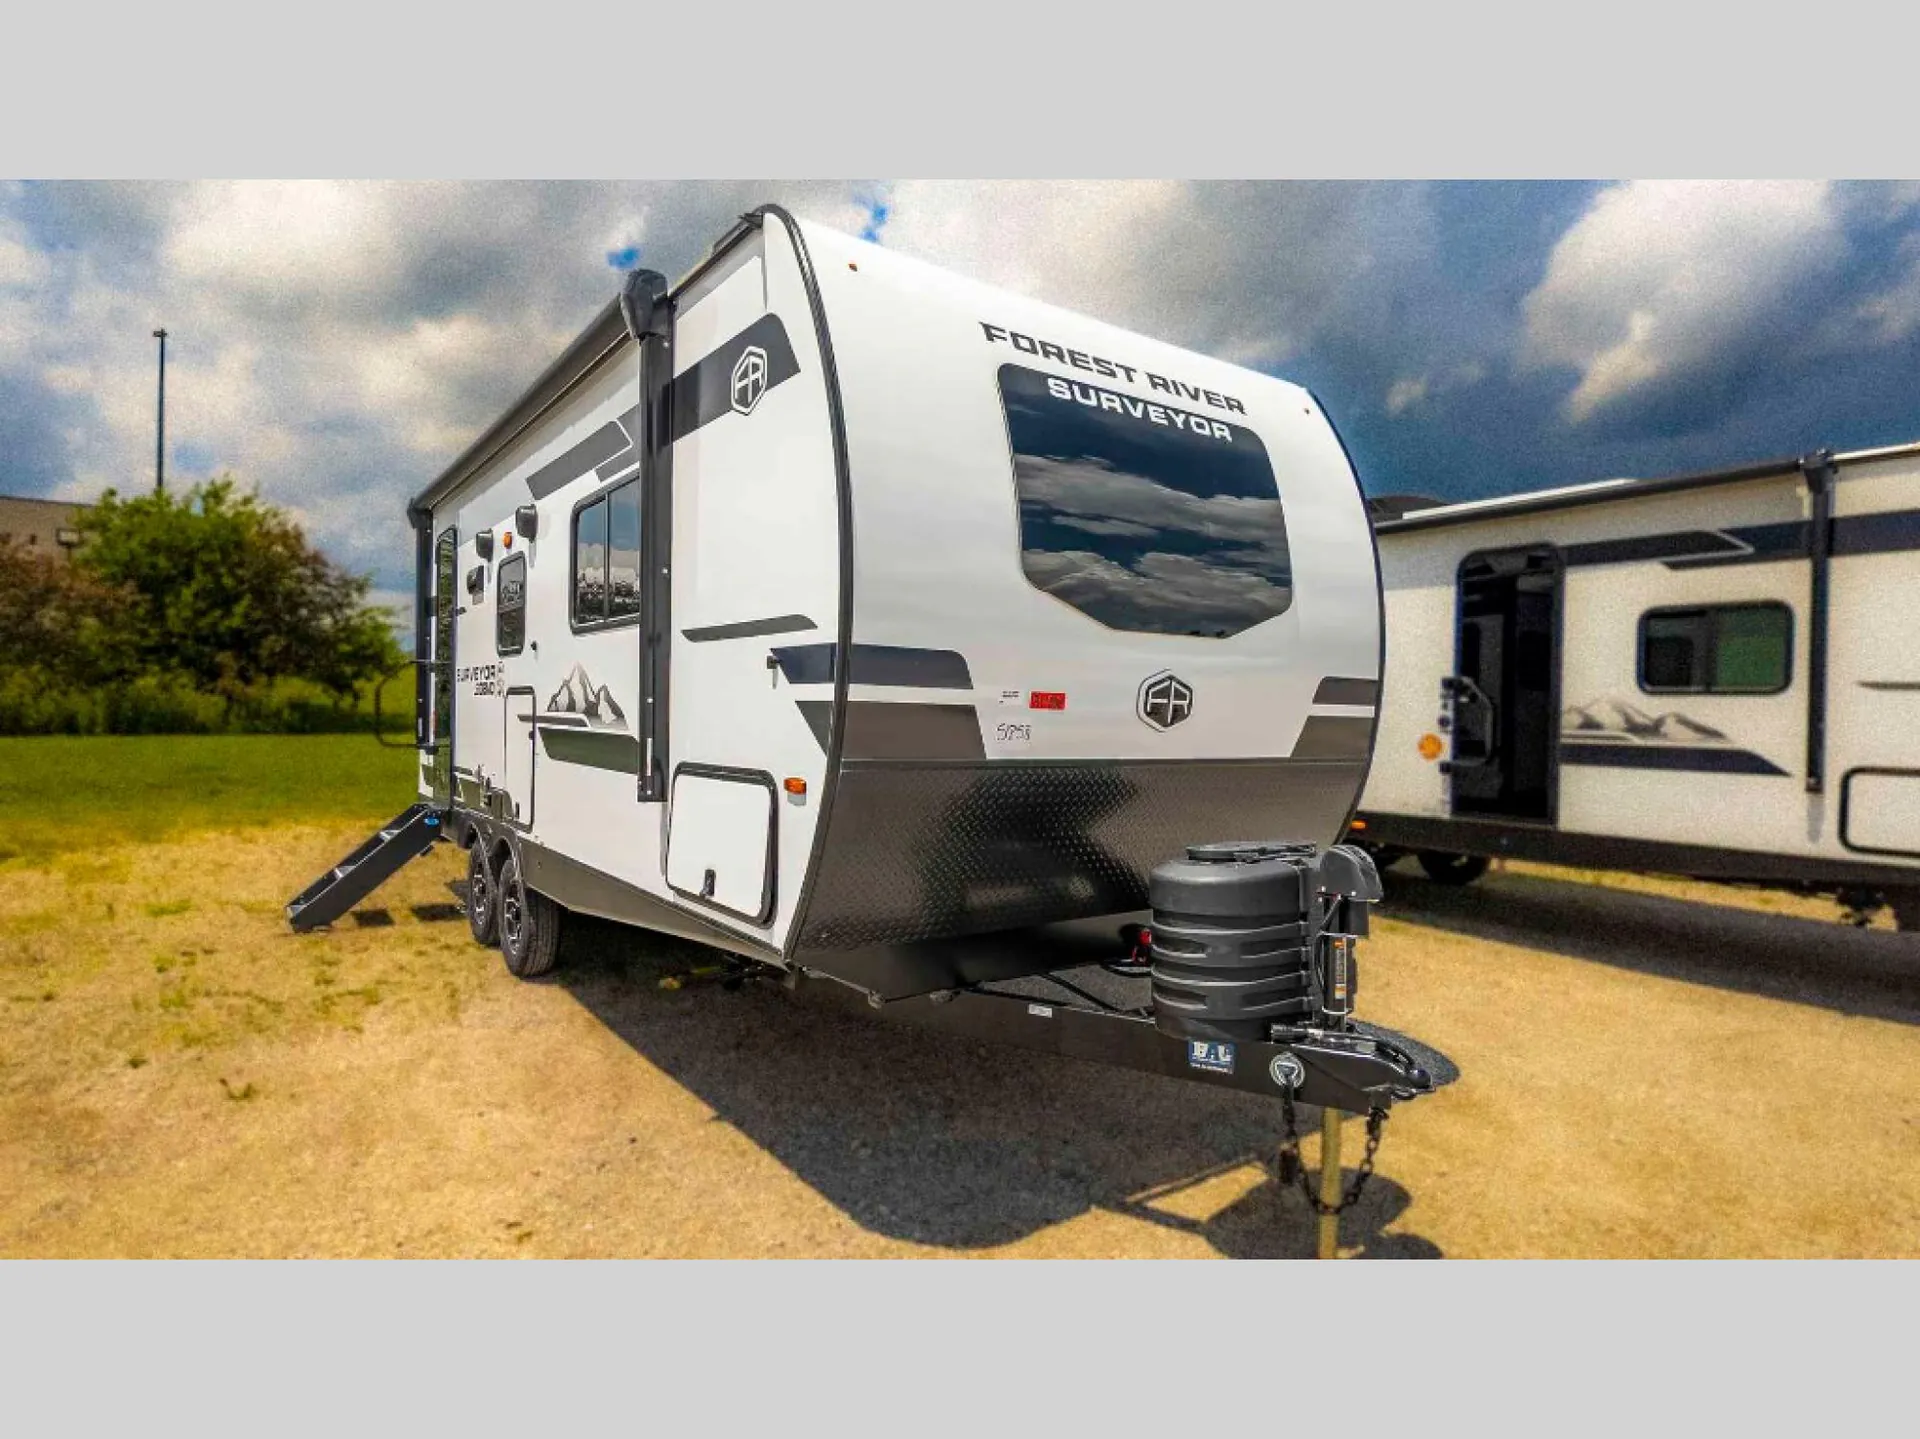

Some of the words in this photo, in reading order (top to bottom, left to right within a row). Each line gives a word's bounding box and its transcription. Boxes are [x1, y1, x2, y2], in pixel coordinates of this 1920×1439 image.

[979, 322, 1136, 382] FOREST
[1145, 371, 1246, 415] RIVER
[1047, 377, 1232, 442] SURVEYOR
